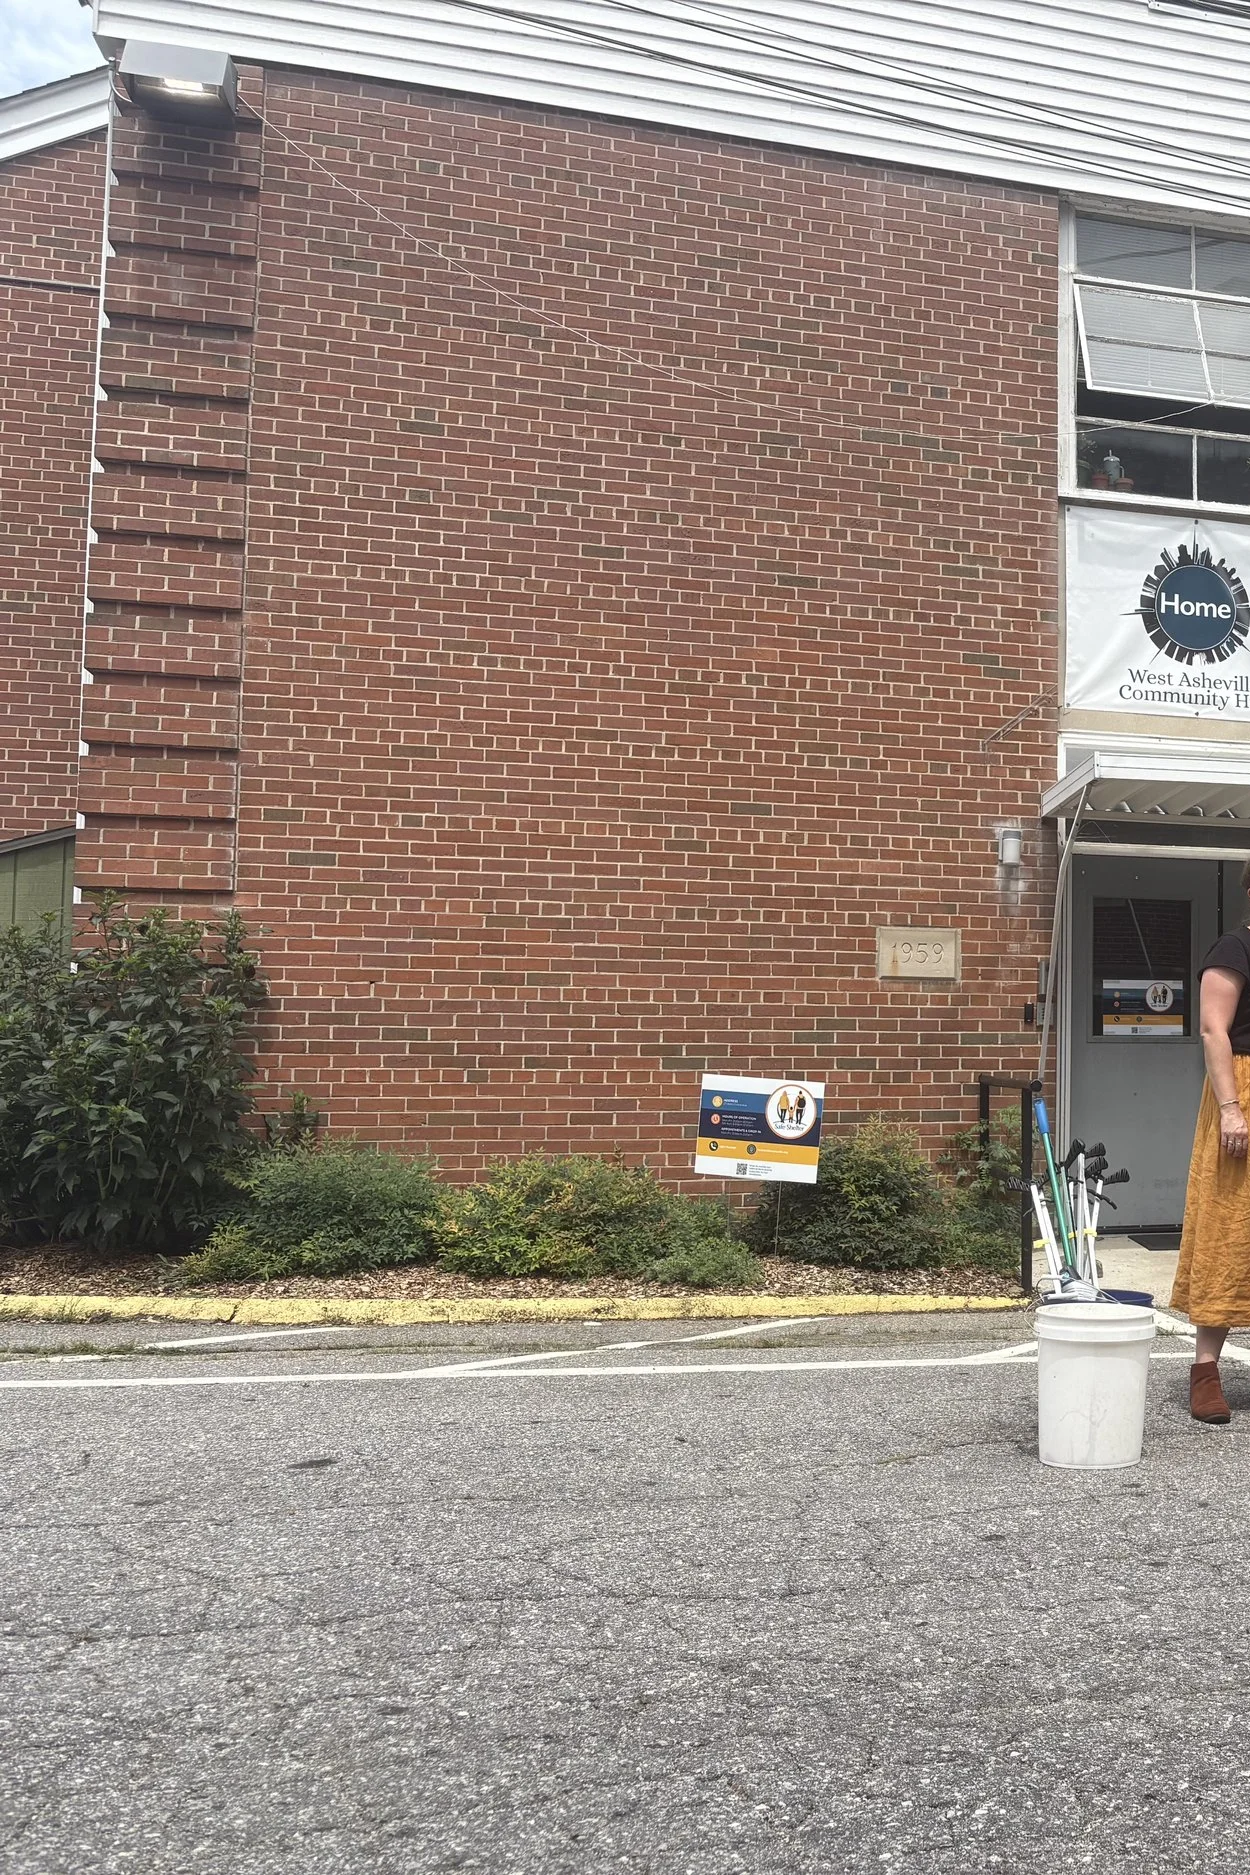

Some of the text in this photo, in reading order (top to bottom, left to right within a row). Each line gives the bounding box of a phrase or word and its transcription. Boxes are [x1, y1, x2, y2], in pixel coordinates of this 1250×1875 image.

[1160, 592, 1232, 619] Home
[1128, 668, 1174, 686] West
[1119, 684, 1230, 711] Community
[891, 942, 944, 964] 1959
